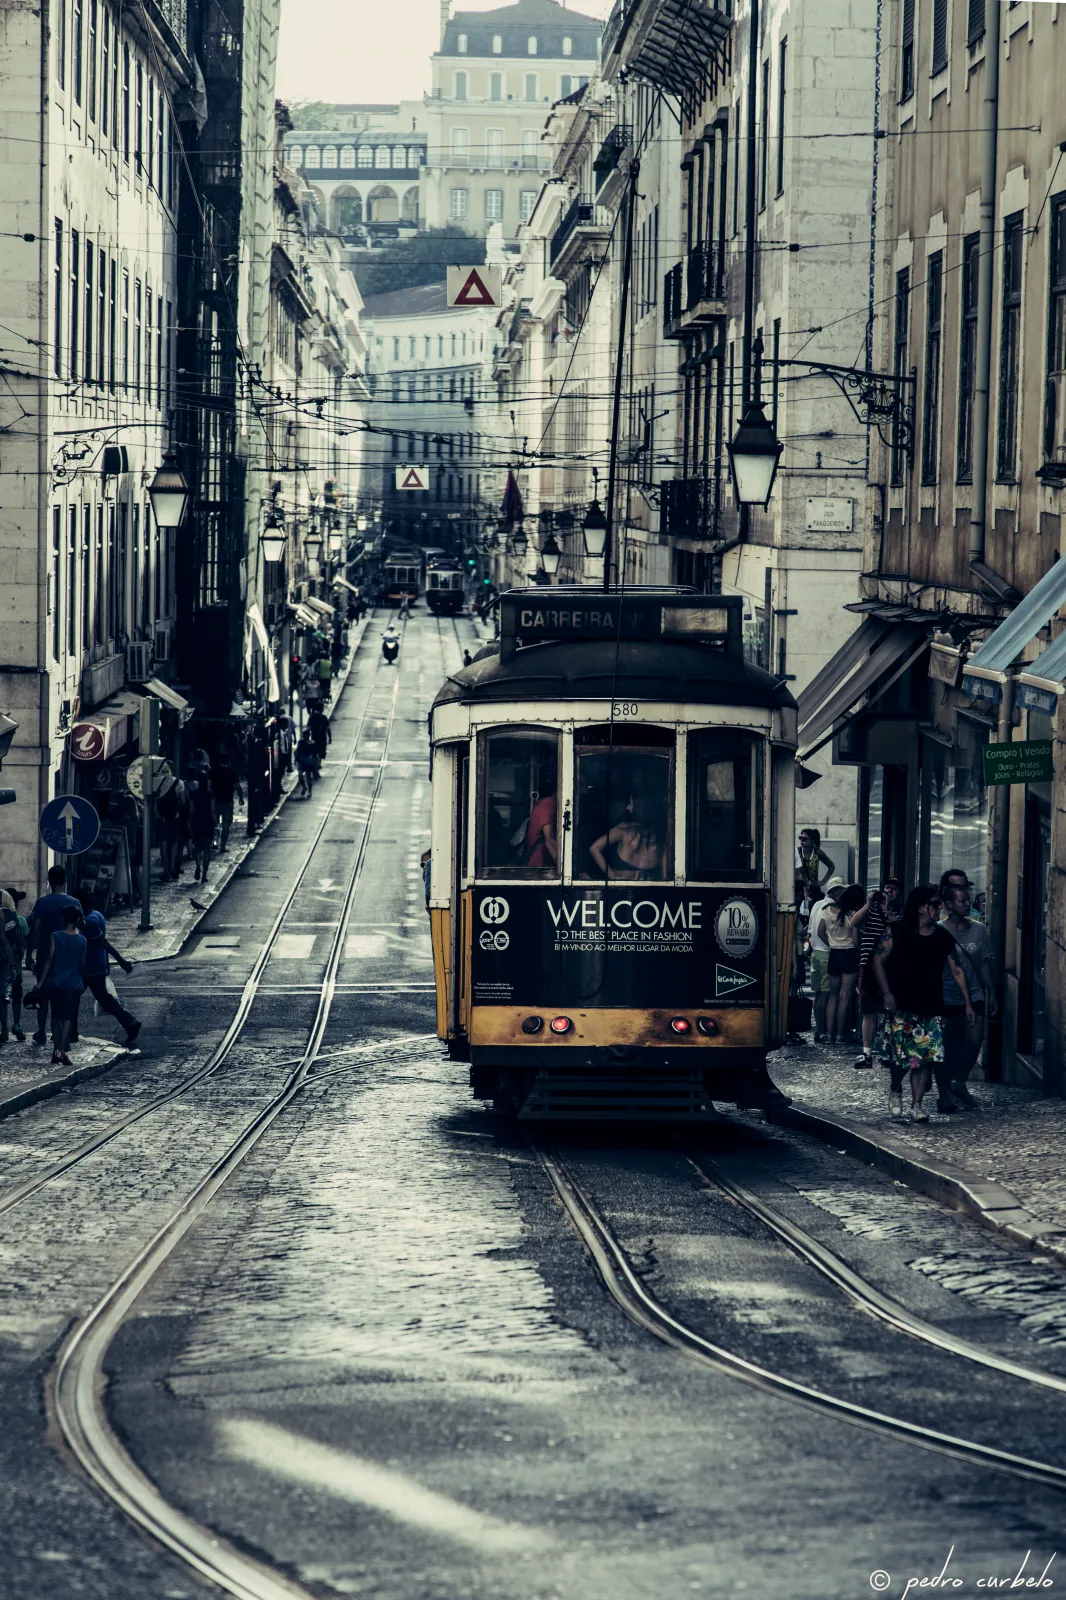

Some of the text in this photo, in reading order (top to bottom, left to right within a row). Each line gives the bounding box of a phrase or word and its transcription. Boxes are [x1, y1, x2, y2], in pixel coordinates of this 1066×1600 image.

[520, 610, 614, 628] CARREIRA
[612, 704, 638, 716] 580
[986, 749, 1018, 759] Compro
[1024, 745, 1051, 755] Vendo
[997, 763, 1014, 771] Ouro
[546, 900, 702, 928] WELCOME
[570, 930, 587, 940] THE
[588, 930, 610, 940] BES
[611, 931, 639, 941] PLACE
[640, 931, 651, 941] IN
[653, 932, 692, 941] FASHION
[726, 929, 750, 937] REWARD
[607, 944, 636, 952] MELHOR
[636, 944, 660, 952] LUGAR
[660, 945, 671, 953] DA
[671, 945, 694, 953] MODA
